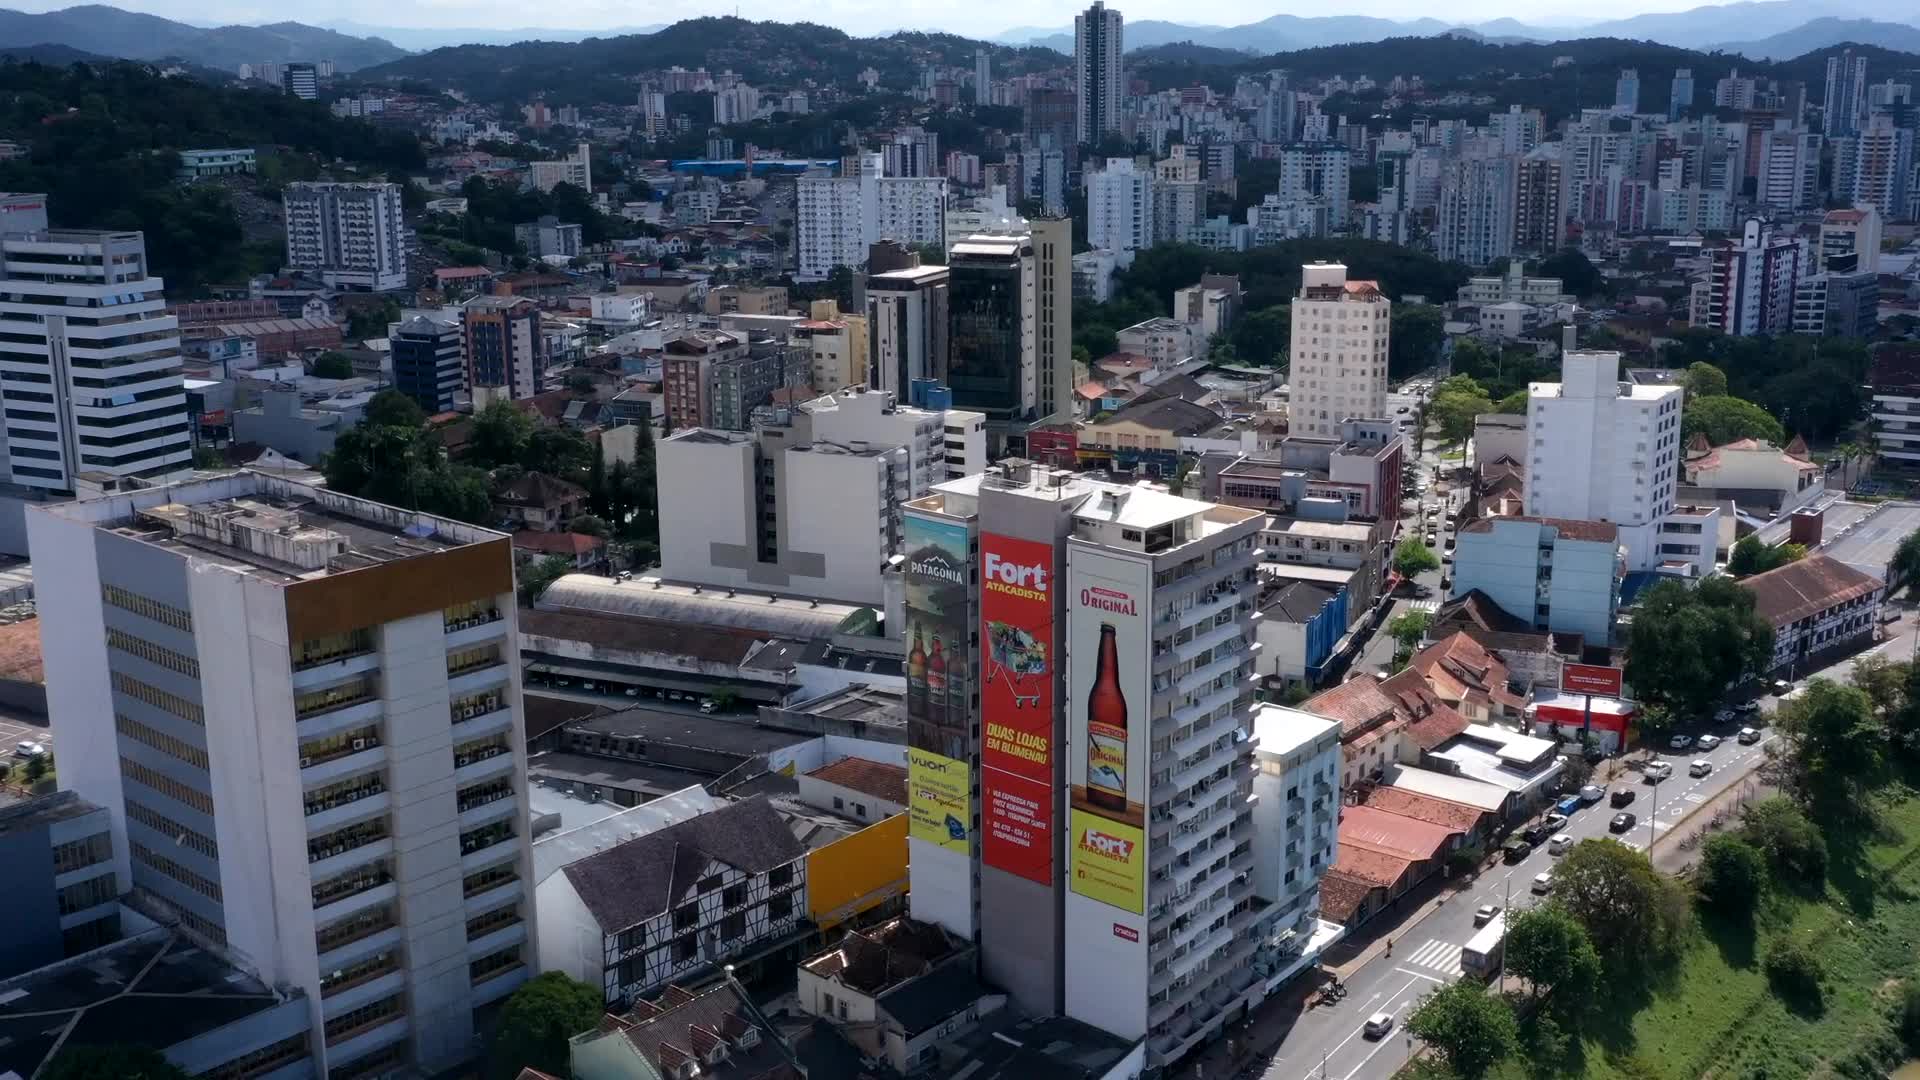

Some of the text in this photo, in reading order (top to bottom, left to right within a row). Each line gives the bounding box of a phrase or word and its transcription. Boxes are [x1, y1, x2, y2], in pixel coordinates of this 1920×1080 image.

[911, 561, 963, 585] PATAGONIA
[986, 552, 1047, 591] Fort
[986, 581, 1046, 602] ATACADISTA
[986, 722, 1047, 752] DUAS LOJAS
[987, 737, 1047, 764] EM BLUMENAU
[1086, 829, 1129, 857] Fort
